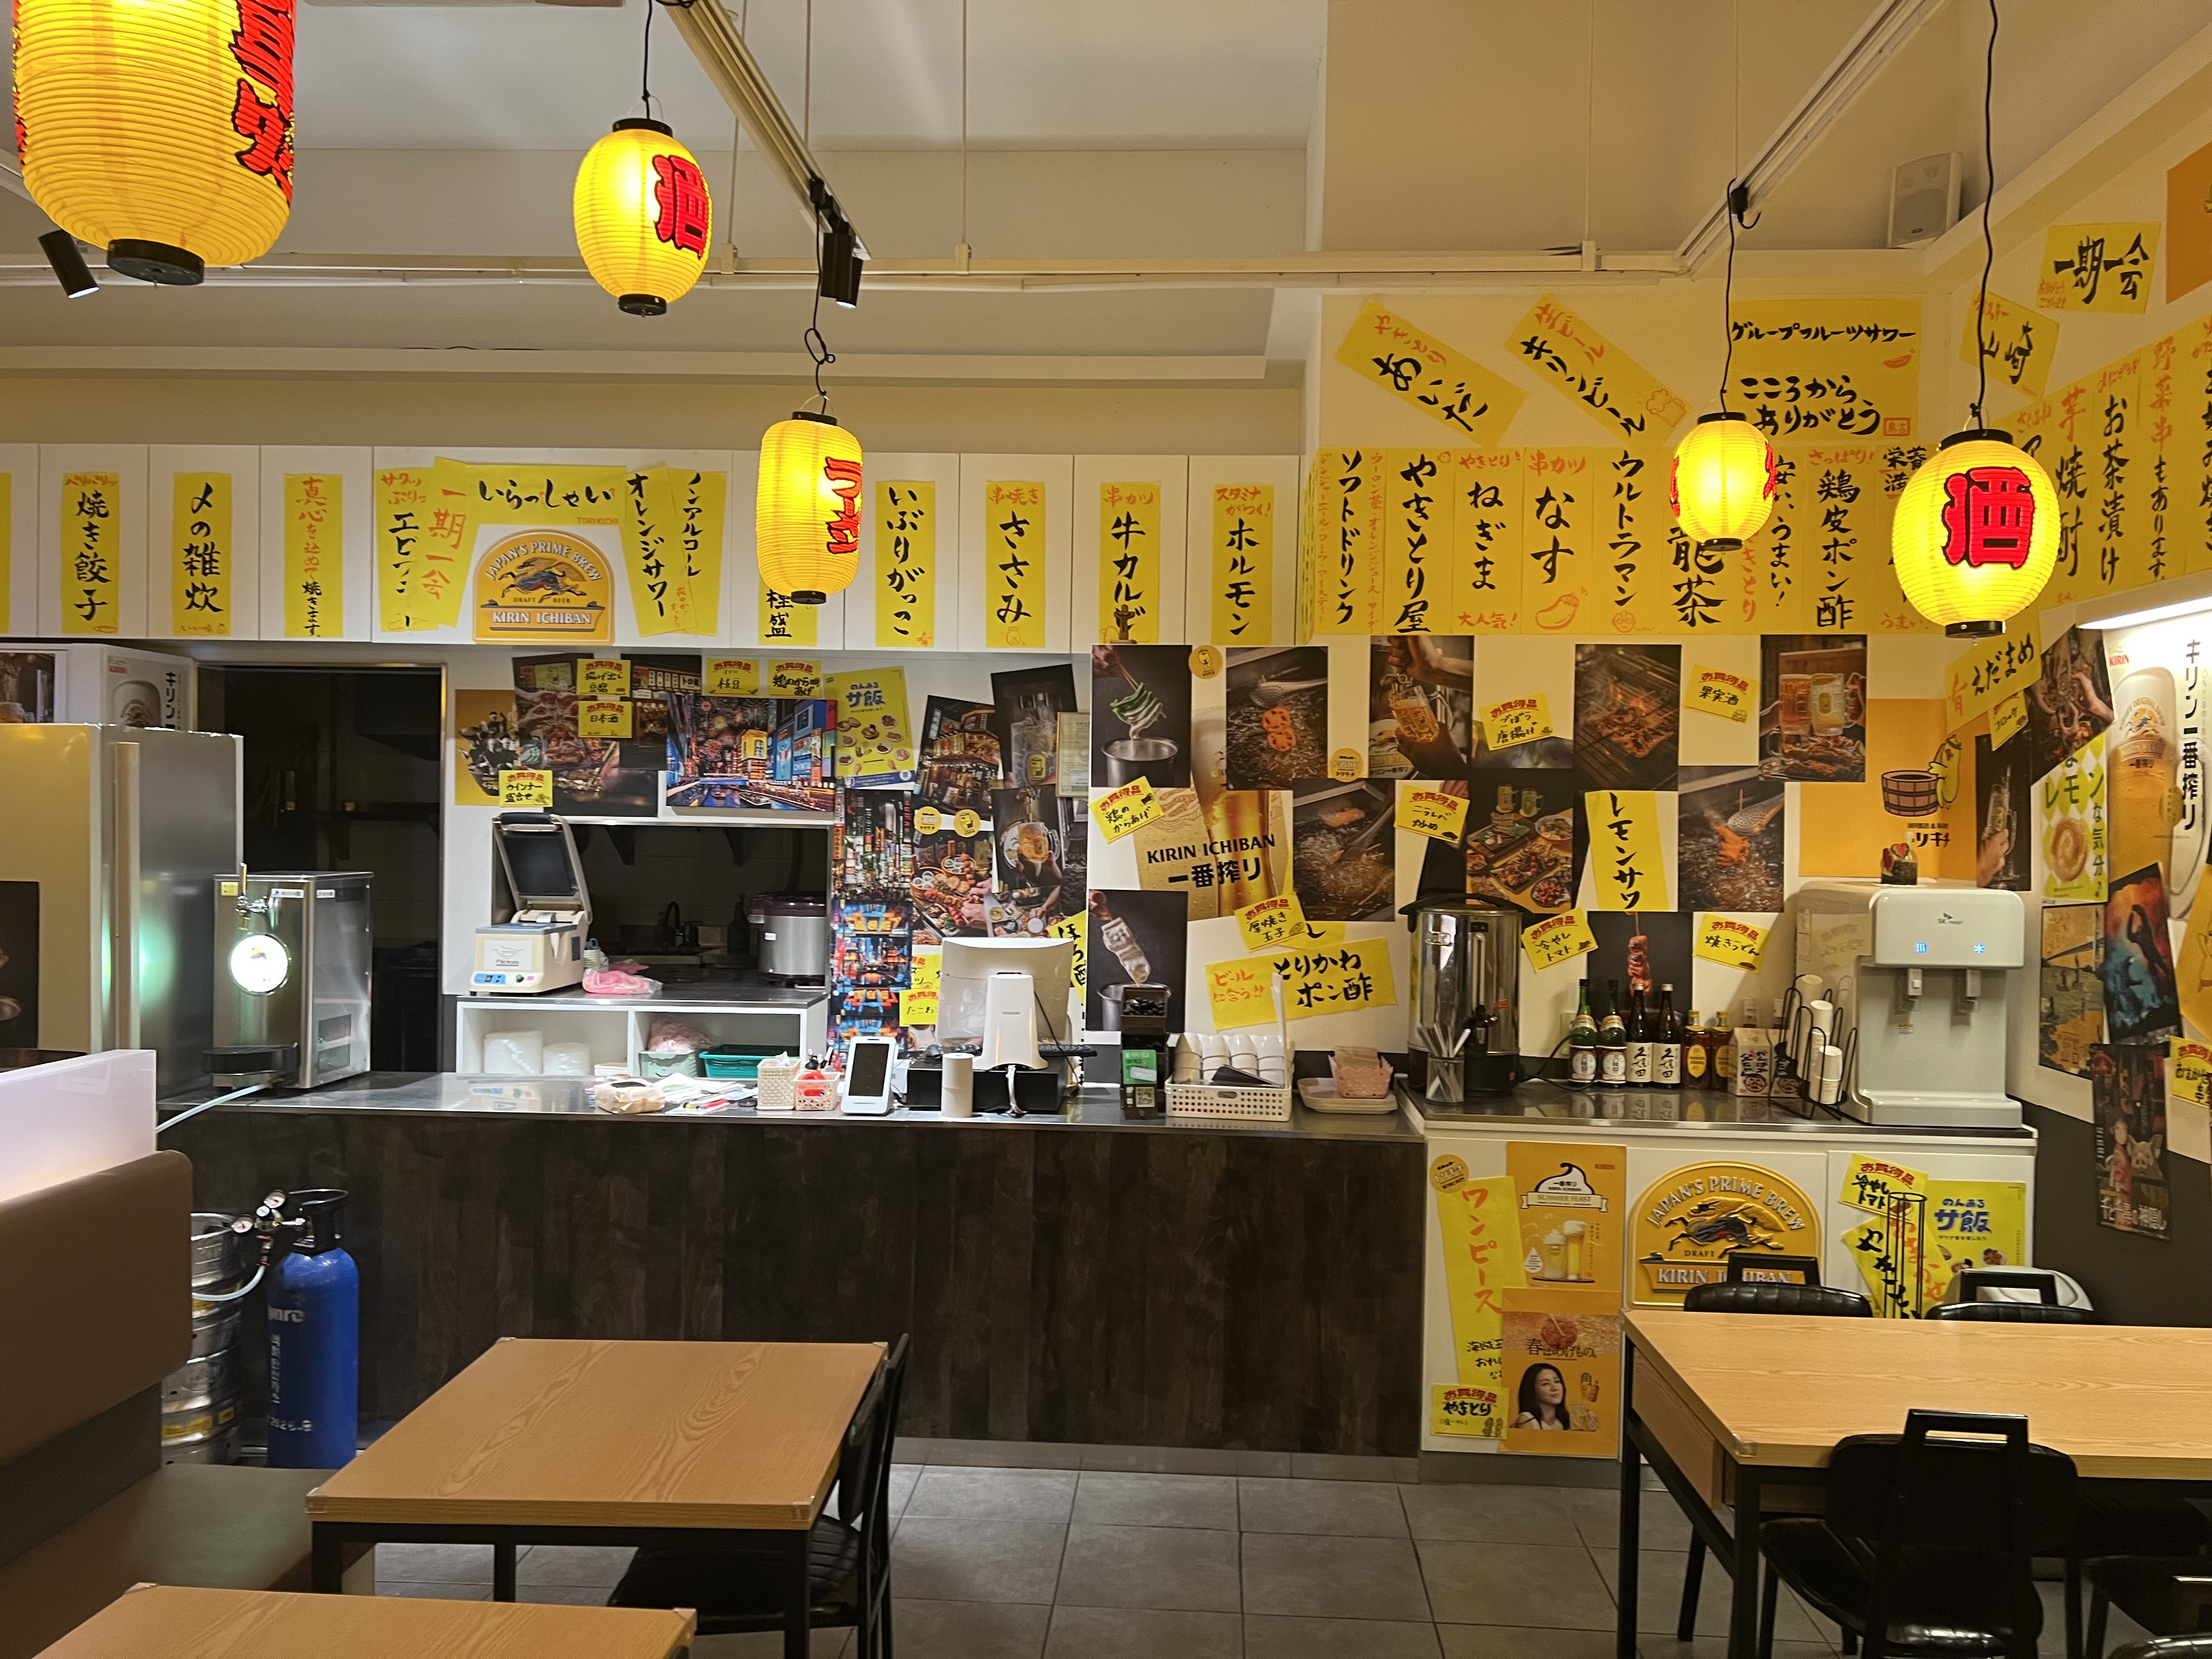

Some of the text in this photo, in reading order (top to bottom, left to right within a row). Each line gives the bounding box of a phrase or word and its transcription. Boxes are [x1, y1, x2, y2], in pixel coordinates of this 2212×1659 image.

[652, 154, 708, 259] 酒
[2053, 232, 2149, 304] 一期一会
[1374, 315, 1447, 365] やきとり
[1534, 303, 1605, 364] 生ビール
[1372, 353, 1488, 432] あいだ
[1520, 336, 1645, 437] キリンビール
[1740, 375, 1858, 404] こころから
[1752, 399, 1881, 436] ありがとう
[1458, 453, 1510, 470] やきとり
[1528, 449, 1587, 477] 串カツ
[479, 478, 611, 510] いらっしゃい
[989, 484, 1040, 506] 串焼き
[1103, 485, 1154, 507] 串カツ
[1216, 486, 1262, 501] スタミナ
[2055, 386, 2090, 578] 芋焼酎
[2098, 393, 2131, 586] お茶漬け
[824, 456, 862, 555] ラーメン
[1942, 466, 2034, 570] 酒
[421, 488, 467, 600] 一期一会
[627, 472, 668, 618] オレンジサワー
[1335, 450, 1363, 625] ソフトドリンク
[1393, 453, 1437, 634] やきとり屋
[1466, 482, 1506, 590] ねぎま
[1530, 486, 1576, 584] なす
[1608, 449, 1645, 607] ウルトラマン
[74, 489, 112, 621] 焼き餃子
[182, 483, 224, 613] 〆の雑炊
[485, 540, 603, 582] JAPAN'S PRIME BREW
[886, 486, 926, 635] いぶりがっこ
[1815, 468, 1862, 630] 鶏皮ポン酢
[996, 511, 1032, 624] ささみ
[1224, 517, 1261, 636] ホルモン
[492, 611, 592, 624] KIRIN ICHIBAN
[1457, 611, 1518, 629] 大人気!
[1972, 633, 2034, 696] えだまめ
[2109, 655, 2130, 667] KIRIN
[716, 677, 741, 690] 枝豆
[846, 690, 885, 708] サ飯
[1699, 685, 1740, 706] 果実酒
[1701, 671, 1750, 692] お買得品
[2185, 639, 2201, 831] キリン一番搾り
[1147, 833, 1276, 864] KIRIN ICHIBAN
[1607, 792, 1644, 909] レモンサワ
[1168, 856, 1261, 888] 一番搾り
[1261, 927, 1285, 943] 玉子
[1705, 935, 1760, 957] 焼きうどん
[1711, 921, 1760, 941] お買得品
[1273, 949, 1362, 980] とりかわ
[1547, 945, 1572, 962] トマト
[1214, 969, 1256, 988] ビール
[1296, 972, 1374, 1008] ポン酢
[906, 1006, 938, 1015] たこわ
[1647, 1176, 1807, 1231] JAPAN'S PRIME BREW
[1858, 1190, 1886, 1210] トマト
[1943, 1198, 1985, 1207] のんある
[1934, 1209, 1992, 1233] サ飯
[1462, 1187, 1504, 1314] ワンピース
[1657, 1268, 1792, 1284] KIRIN IIBAN
[1443, 1401, 1491, 1417] やきとり
